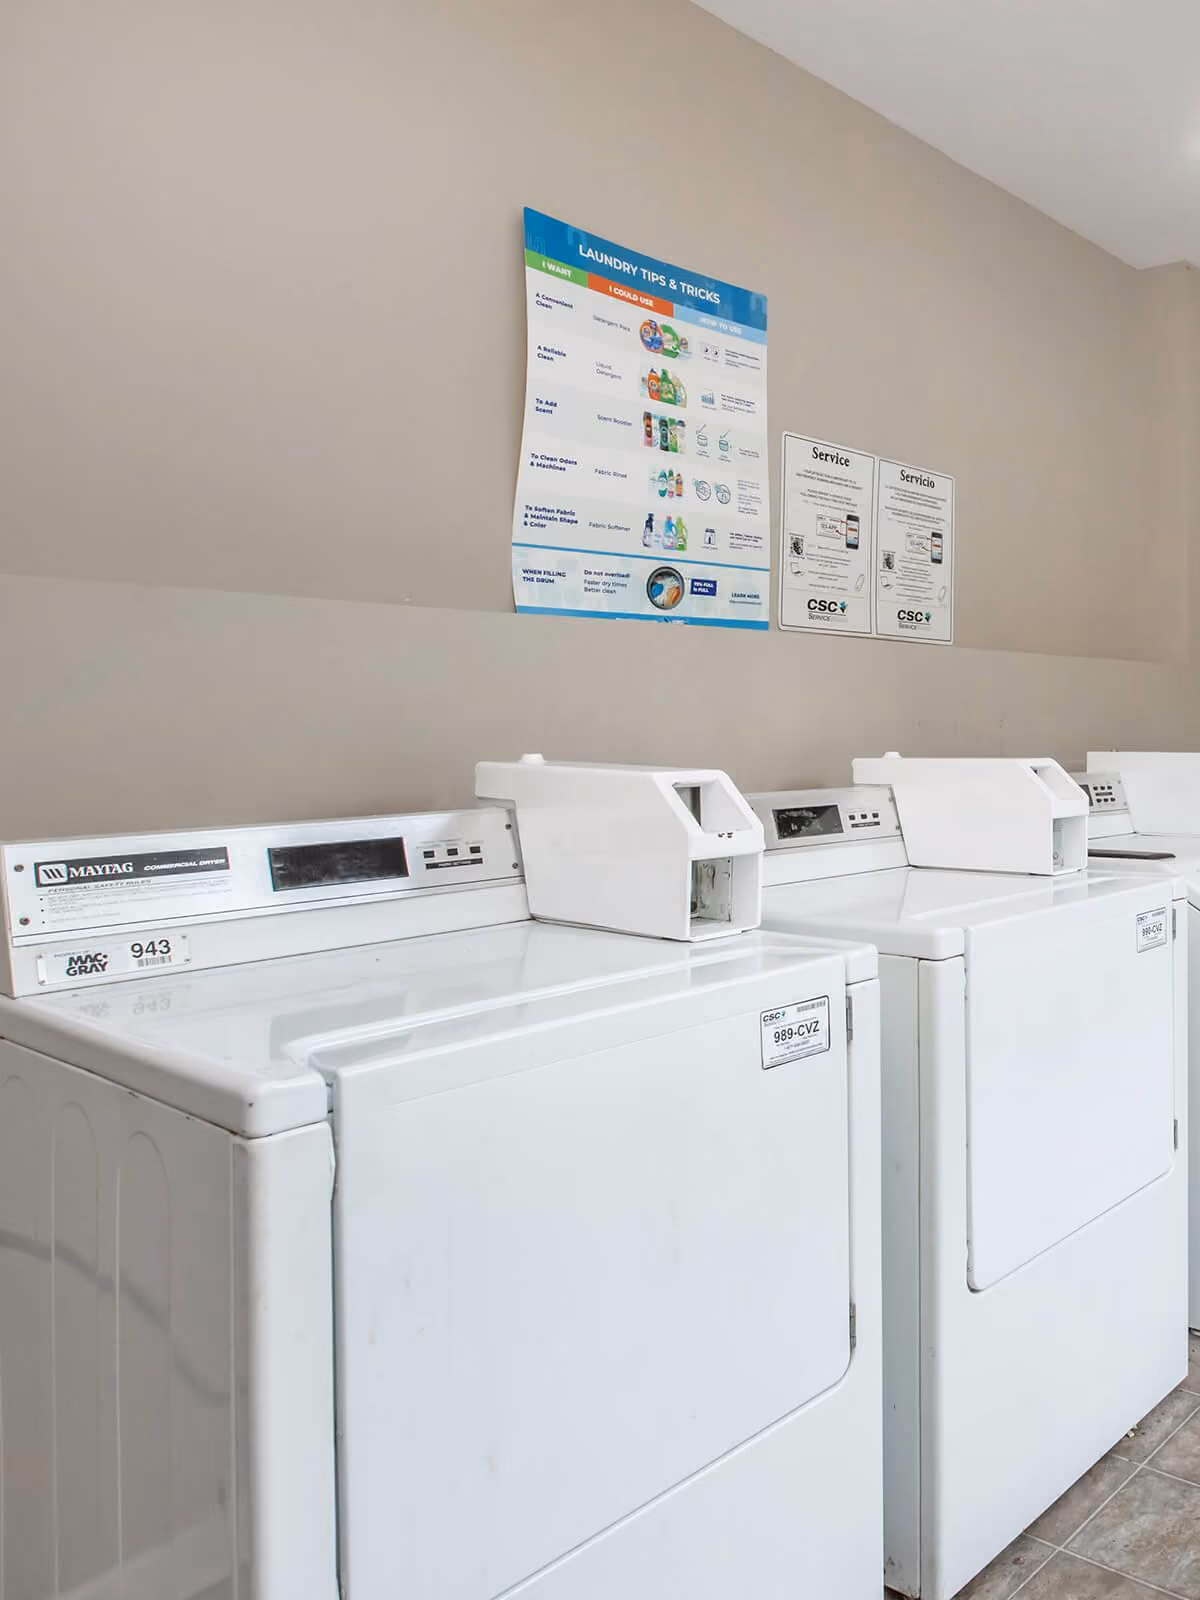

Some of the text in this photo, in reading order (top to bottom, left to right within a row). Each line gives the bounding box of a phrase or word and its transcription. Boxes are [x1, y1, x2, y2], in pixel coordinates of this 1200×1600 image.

[547, 262, 572, 278] WANT
[579, 244, 720, 304] LAUNDRY TIPS & TRICKS
[541, 294, 573, 309] Convenient
[613, 287, 638, 302] COULD
[639, 295, 654, 307] USE
[536, 300, 552, 310] Clean
[537, 352, 554, 361] Clean
[543, 346, 566, 357] Reliable
[545, 400, 557, 408] Add
[536, 406, 553, 415] Scent
[540, 454, 558, 462] Clean
[812, 446, 851, 467] Service
[536, 462, 566, 472] Machines
[595, 468, 612, 477] Fabric
[900, 469, 936, 489] Servicio
[534, 506, 555, 514] Soften
[556, 508, 576, 517] Fabric
[530, 513, 558, 522] Maintain
[560, 517, 579, 525] Shape
[530, 521, 547, 529] Color
[589, 521, 631, 532] Fabric Softener
[522, 568, 567, 578] WHEN FILLING
[602, 580, 611, 588] dry
[612, 581, 628, 589] times
[807, 598, 838, 613] CSC
[897, 609, 924, 622] CSC
[143, 858, 226, 871] COMMERCIAL DRYER
[69, 862, 134, 879] MAYTAG
[130, 939, 171, 959] 943
[66, 961, 109, 977] GRAY
[763, 1012, 781, 1022] CSC
[774, 1020, 820, 1043] 989-CVZ
